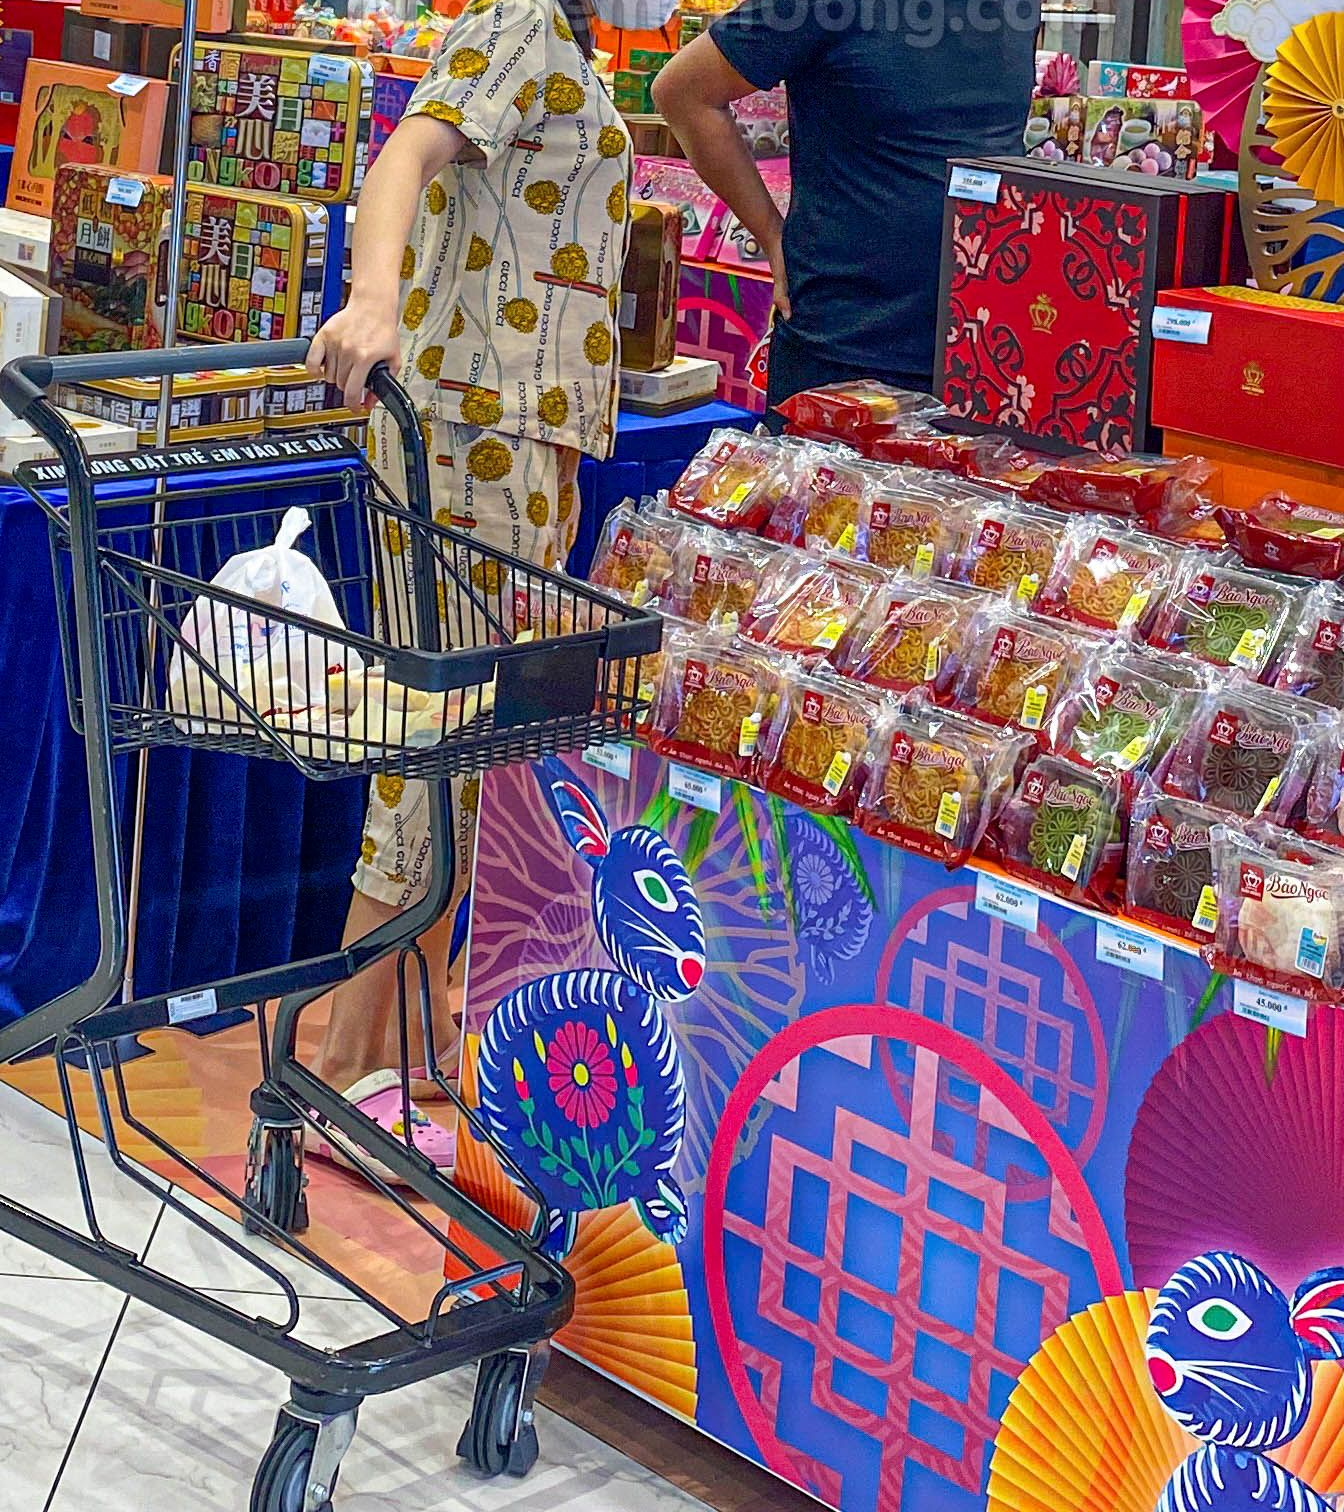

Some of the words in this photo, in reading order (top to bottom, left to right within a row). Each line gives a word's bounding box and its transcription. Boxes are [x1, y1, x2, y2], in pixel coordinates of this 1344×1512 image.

[31, 464, 67, 481] XIN
[90, 455, 127, 475] ỪNG
[211, 445, 242, 463] EM
[242, 439, 280, 462] VÀO
[280, 438, 308, 456] XE
[1256, 997, 1282, 1014] 45.000
